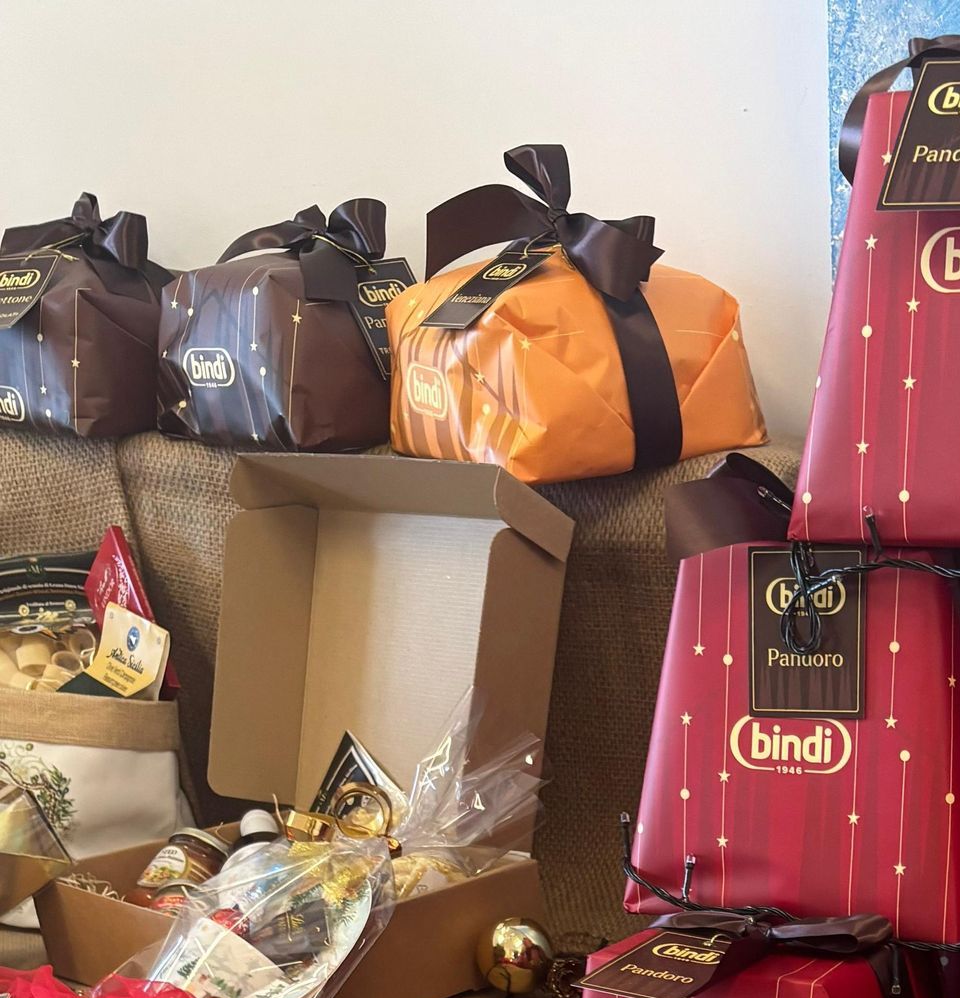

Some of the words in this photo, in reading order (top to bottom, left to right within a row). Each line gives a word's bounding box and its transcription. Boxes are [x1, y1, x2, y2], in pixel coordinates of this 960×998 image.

[0, 272, 34, 287] bindi
[362, 283, 400, 302] bindi
[190, 353, 228, 380] bindi
[413, 369, 442, 409] bindi
[751, 721, 833, 764] bindi
[775, 765, 803, 775] 1946
[664, 945, 721, 962] bindi
[620, 963, 694, 985] Pandoro
